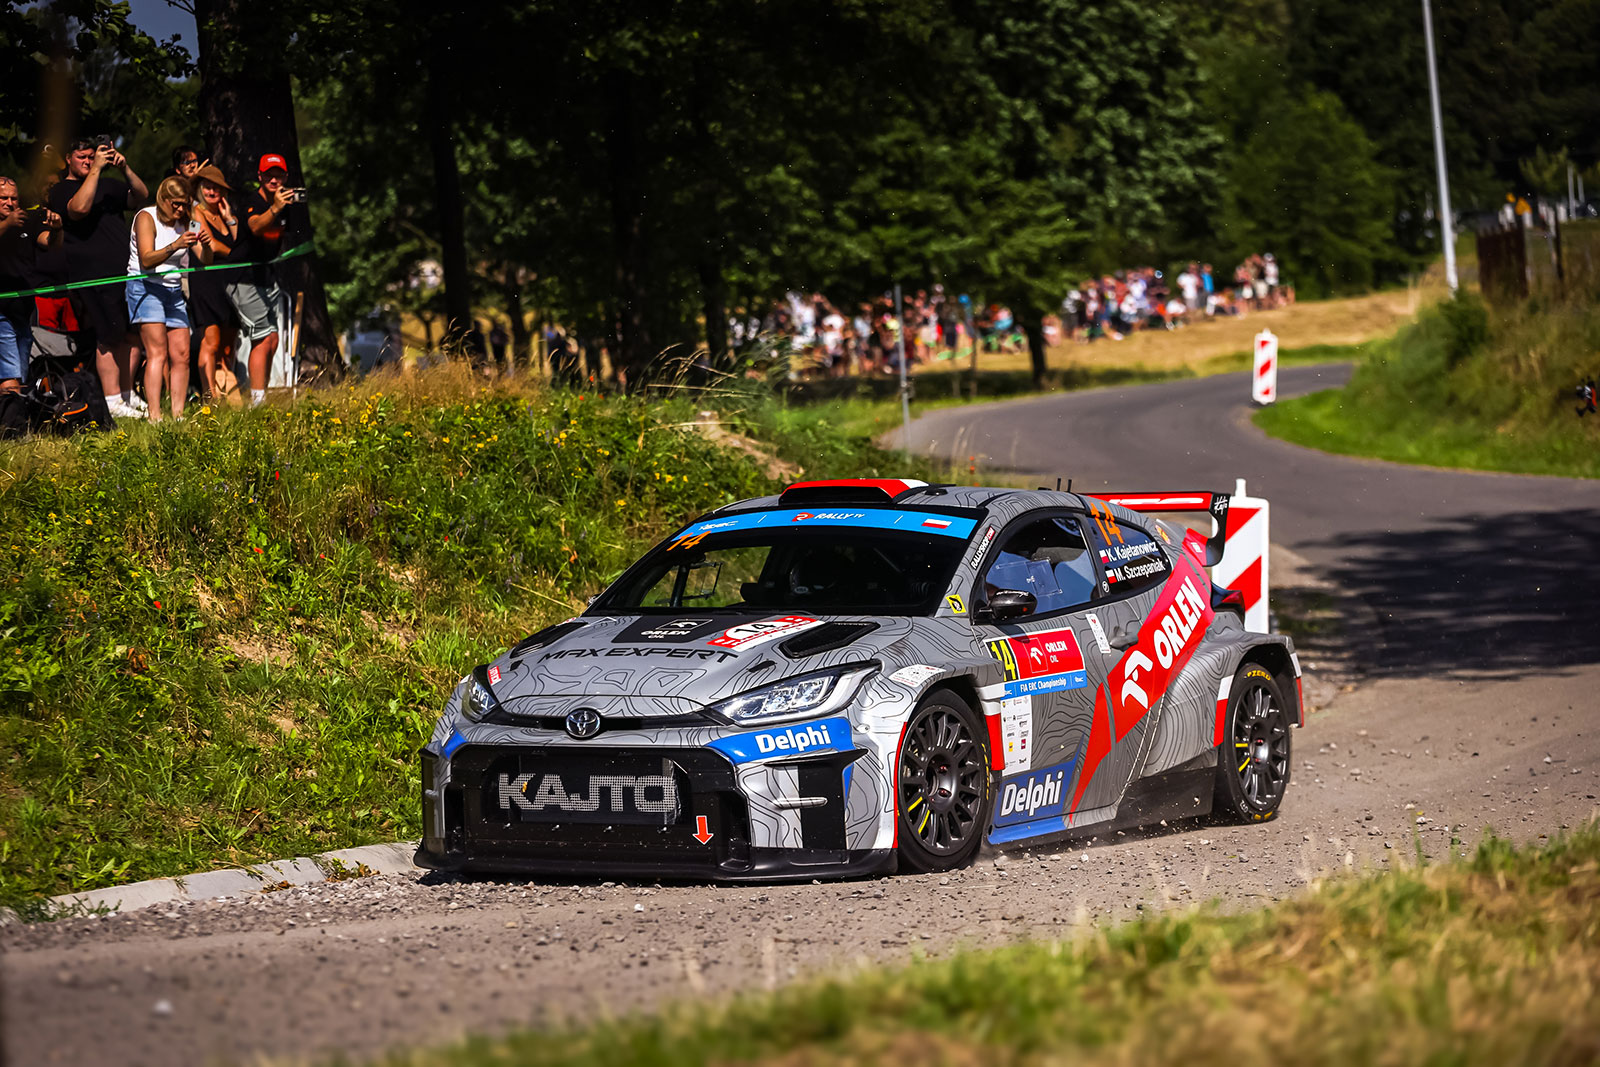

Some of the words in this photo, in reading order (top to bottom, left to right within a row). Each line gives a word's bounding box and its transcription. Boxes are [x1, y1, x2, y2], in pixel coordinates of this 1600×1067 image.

[814, 512, 854, 520] RALLY
[1089, 502, 1124, 546] 14
[666, 530, 712, 552] 14
[1105, 548, 1117, 562] K.
[1114, 540, 1159, 561] Kajetanowicz
[1114, 567, 1126, 582] M.
[1123, 558, 1166, 578] Szczepaniak
[734, 623, 776, 633] 14
[1153, 575, 1206, 669] ORLEN
[537, 648, 603, 664] MAX
[603, 647, 739, 664] EXPERT
[1045, 640, 1068, 653] ORLEN
[1049, 654, 1059, 663] OIL
[1020, 683, 1029, 693] FIA
[1028, 681, 1038, 692] ERC
[1037, 677, 1067, 690] Championship
[755, 724, 832, 753] Delphi
[499, 772, 677, 813] KAJTO
[1001, 771, 1063, 817] Delphi
